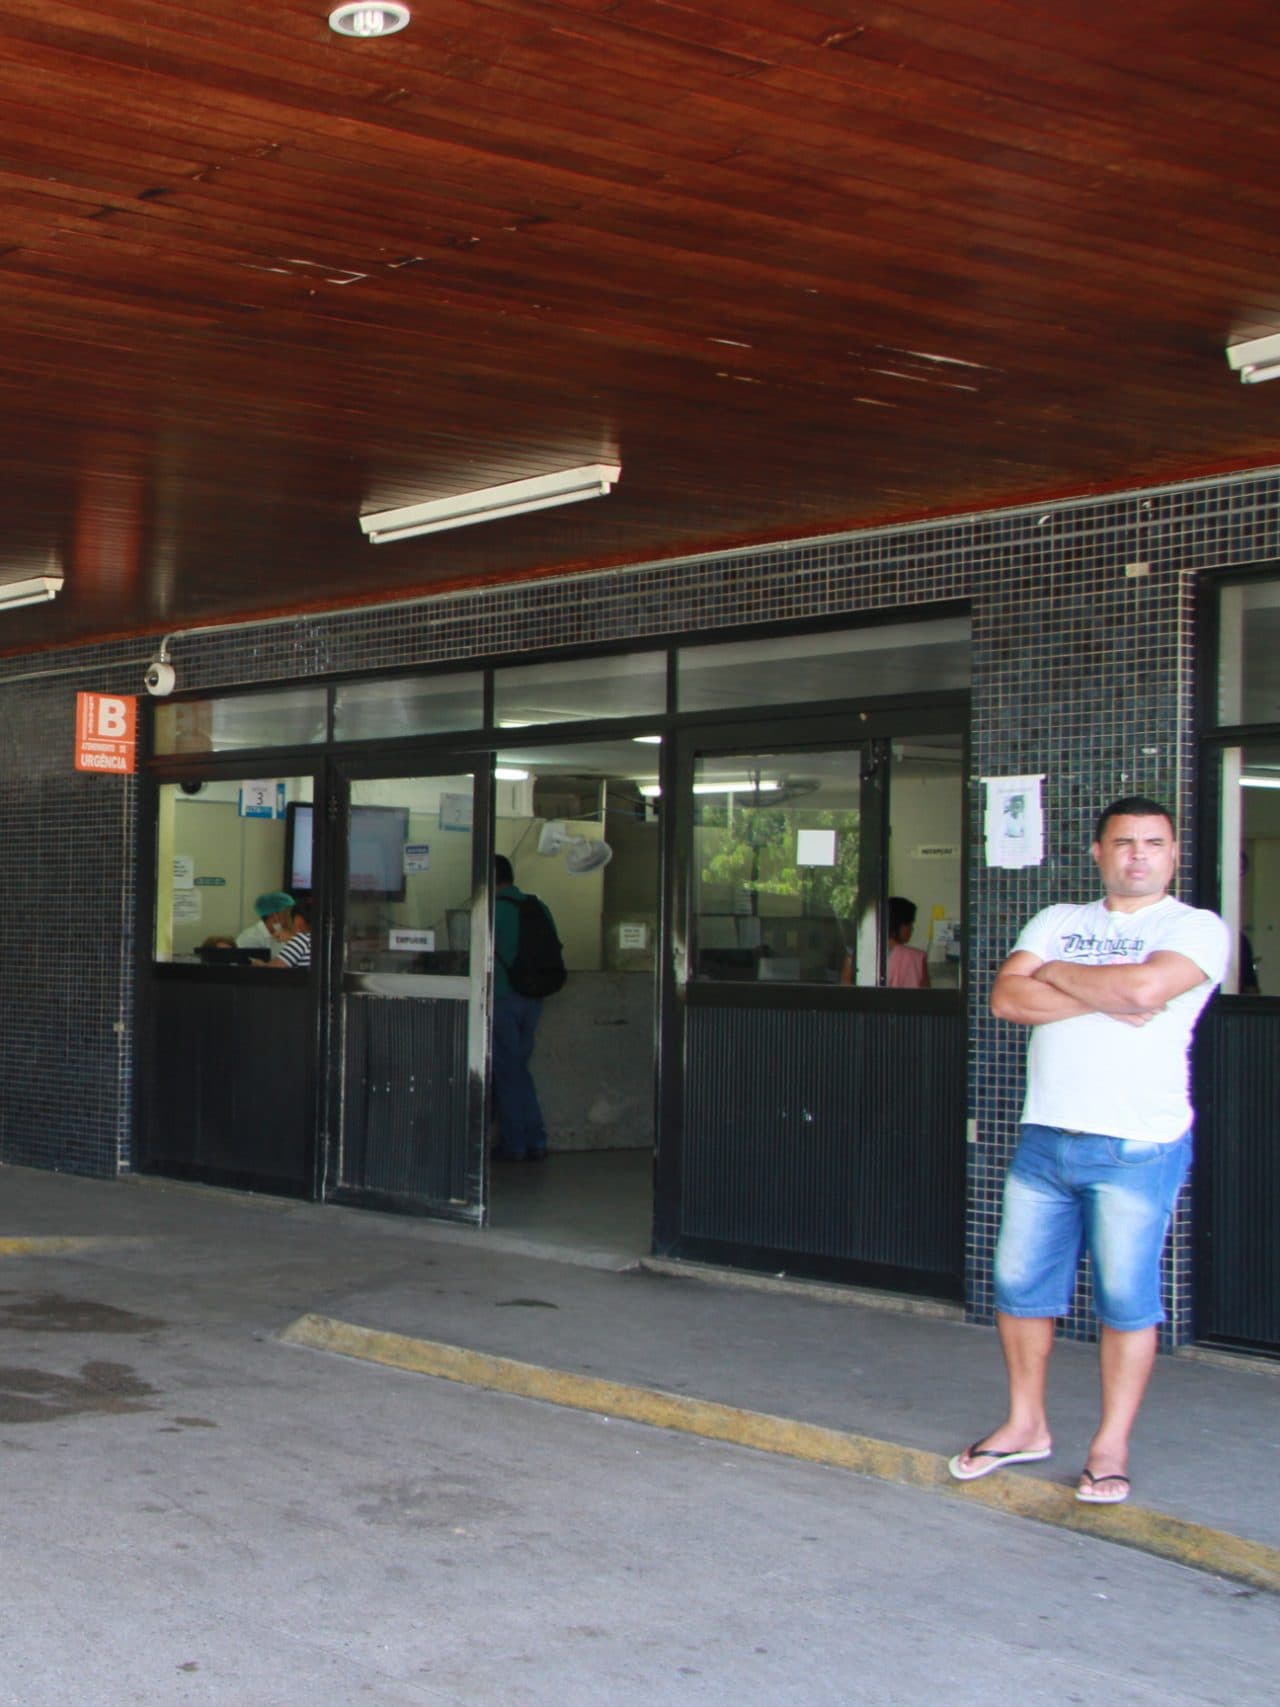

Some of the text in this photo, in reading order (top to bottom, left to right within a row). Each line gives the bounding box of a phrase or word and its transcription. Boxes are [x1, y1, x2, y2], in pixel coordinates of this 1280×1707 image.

[98, 697, 127, 737] B
[81, 753, 127, 769] URGÊNCIA
[256, 791, 264, 806] 3
